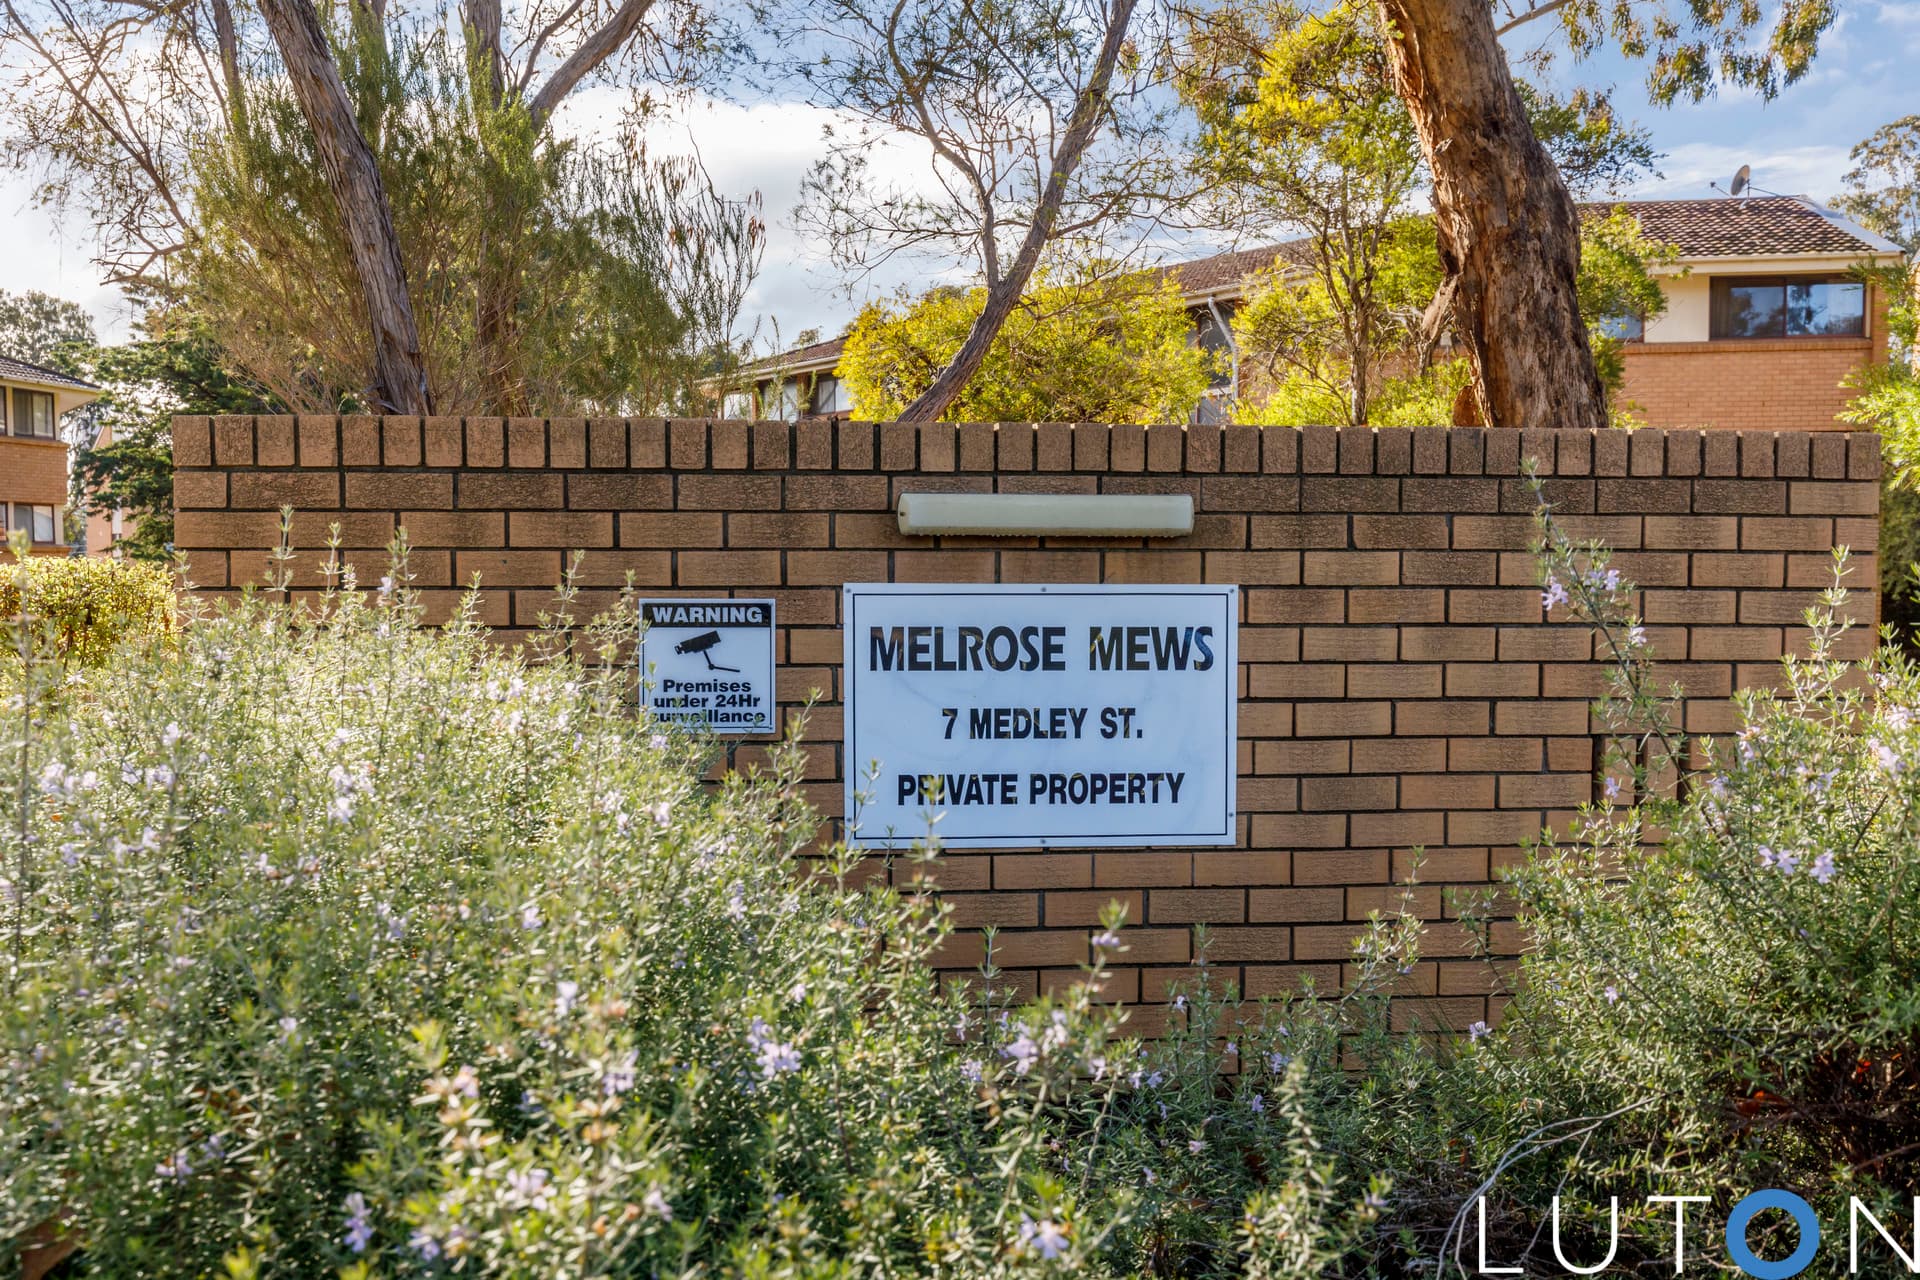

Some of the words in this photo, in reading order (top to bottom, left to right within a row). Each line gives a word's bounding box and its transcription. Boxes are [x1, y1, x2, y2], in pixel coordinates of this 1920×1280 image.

[652, 607, 762, 623] WARNING
[869, 626, 1066, 671] MELROSE
[1089, 626, 1214, 671] MEWS
[663, 679, 751, 692] Premises
[654, 695, 709, 708] under
[715, 695, 760, 708] 24Hr
[942, 708, 958, 740] 7
[969, 708, 1088, 740] MEDLEY
[1100, 707, 1143, 739] ST.
[898, 774, 1018, 806] PRIVATE
[1029, 773, 1186, 805] PROPERTY
